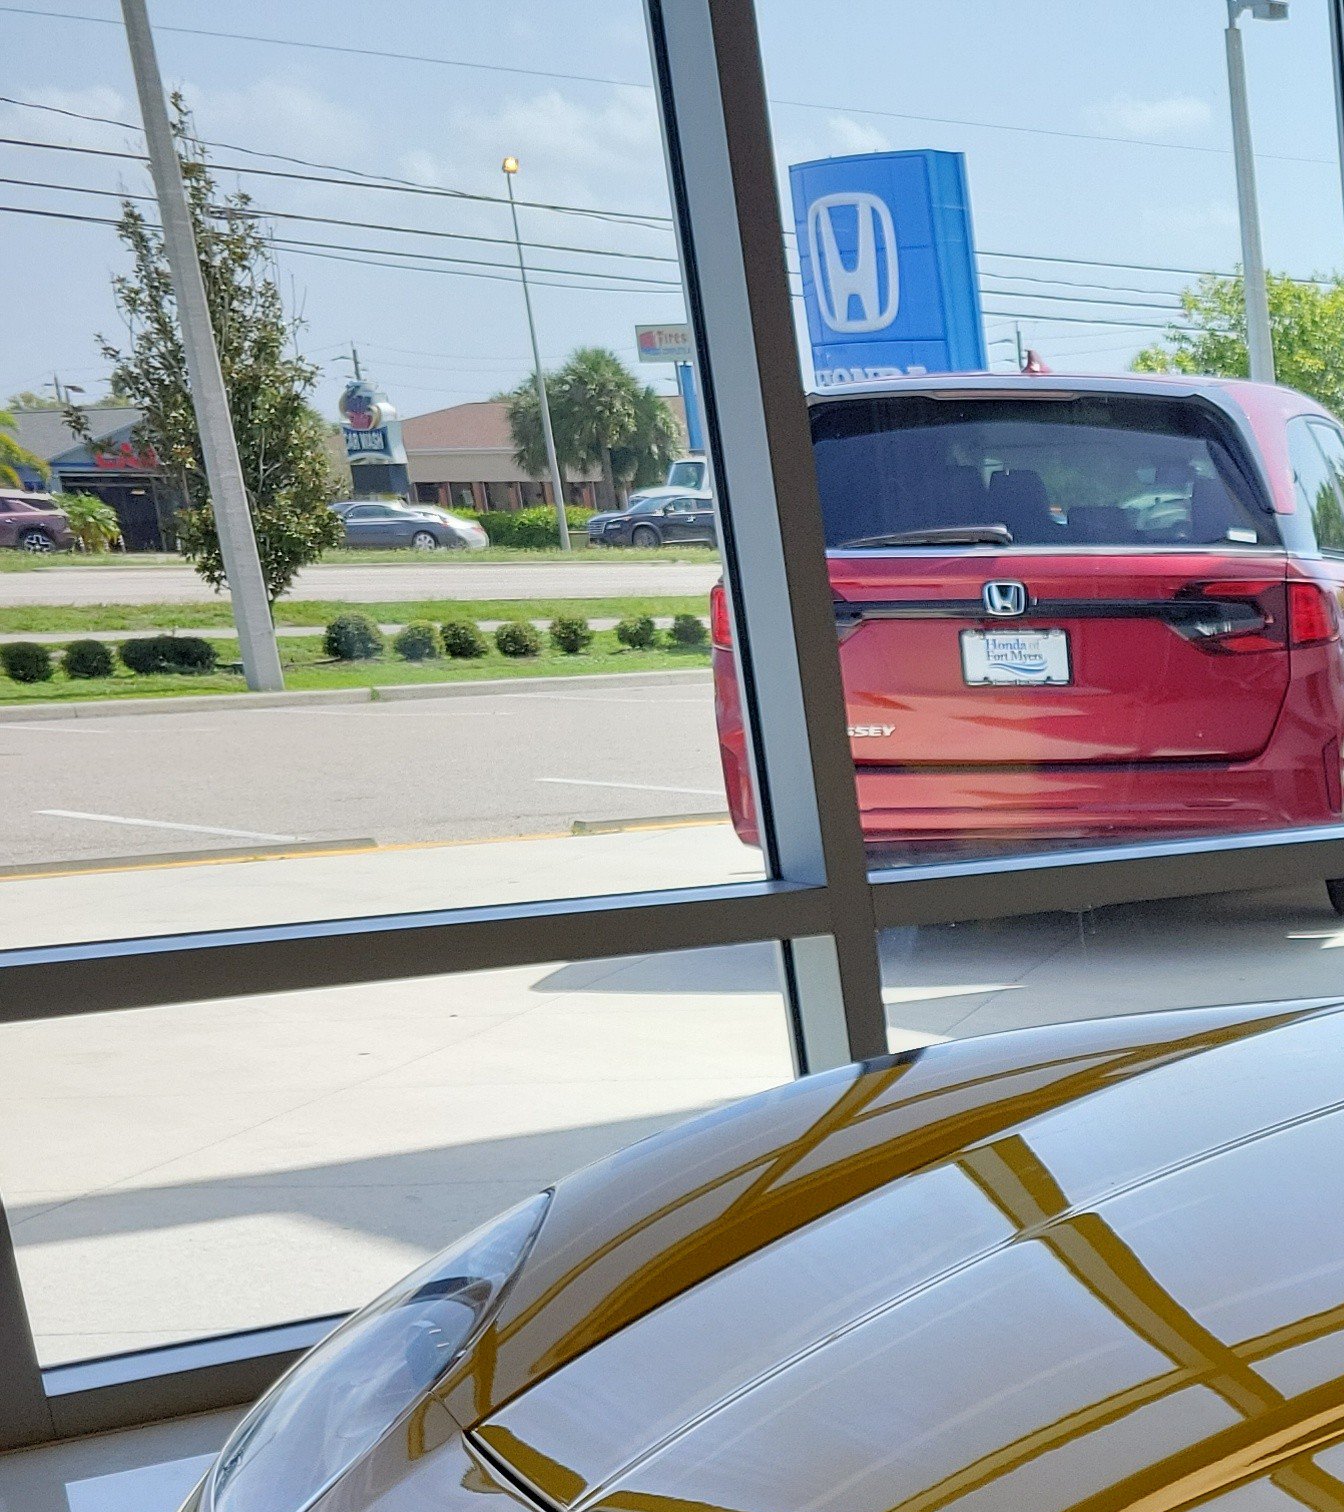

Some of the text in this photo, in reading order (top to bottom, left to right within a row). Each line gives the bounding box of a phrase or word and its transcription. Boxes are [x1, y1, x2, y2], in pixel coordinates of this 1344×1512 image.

[985, 638, 1041, 650] Honda of
[986, 651, 1044, 663] Fort Myers
